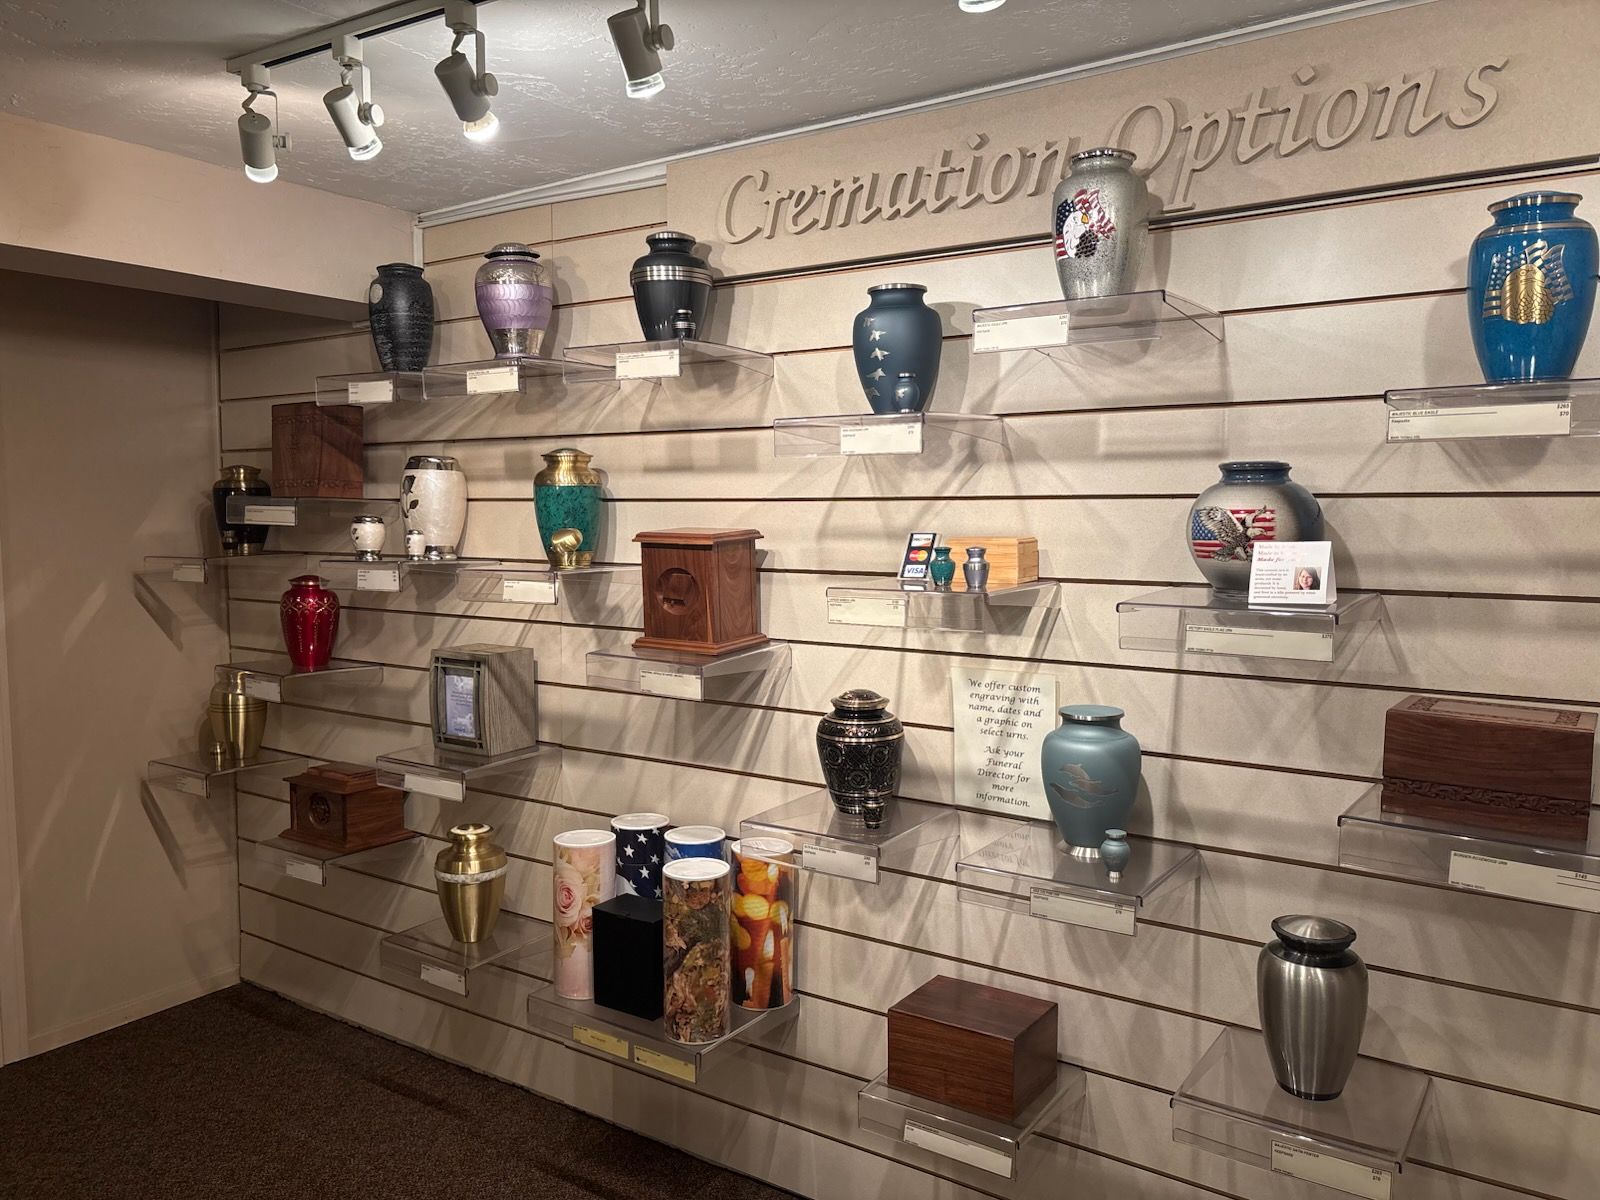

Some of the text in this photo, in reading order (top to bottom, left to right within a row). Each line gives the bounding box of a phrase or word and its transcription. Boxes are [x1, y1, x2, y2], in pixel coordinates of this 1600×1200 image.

[718, 58, 1510, 244] Cremation Options
[968, 678, 1041, 693] We offer custom
[970, 692, 1040, 705] engraving with
[968, 704, 1043, 717] name, dates and
[984, 718, 1019, 729] graphic
[980, 728, 1028, 740] select urns.
[984, 746, 1024, 758] Ask your
[986, 758, 1023, 770] Funeral
[977, 769, 1030, 783] Director for
[992, 783, 1014, 792] more
[976, 792, 1030, 808] information.
